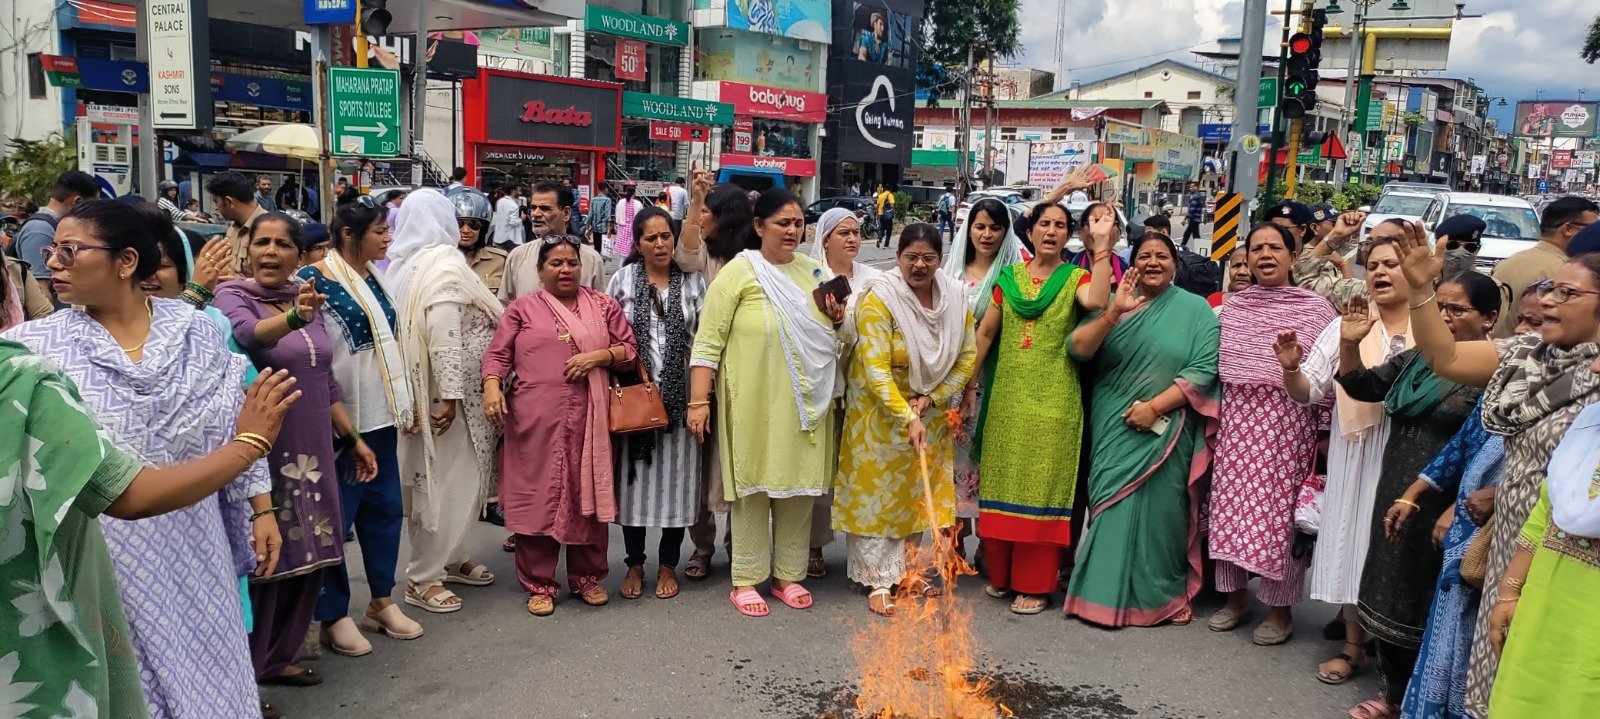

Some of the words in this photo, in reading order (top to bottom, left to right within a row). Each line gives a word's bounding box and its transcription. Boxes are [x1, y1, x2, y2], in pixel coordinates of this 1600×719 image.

[152, 3, 185, 15] CENTRAL
[154, 20, 183, 32] PALACE
[601, 15, 664, 37] WOODLAND
[623, 45, 638, 55] SALE
[61, 76, 80, 84] Petrol
[158, 70, 185, 80] KASHMIRI
[164, 84, 180, 94] SONS
[336, 76, 370, 94] MAHARANA
[370, 77, 394, 95] PRATAP
[749, 86, 805, 111] babyhug
[339, 100, 363, 117] SPORTS
[364, 101, 393, 118] COLLEGE
[520, 100, 593, 127] Bata
[643, 100, 704, 118] WOODLAND
[655, 127, 667, 136] SALE
[737, 136, 750, 145] 199
[753, 158, 787, 170] babyhug
